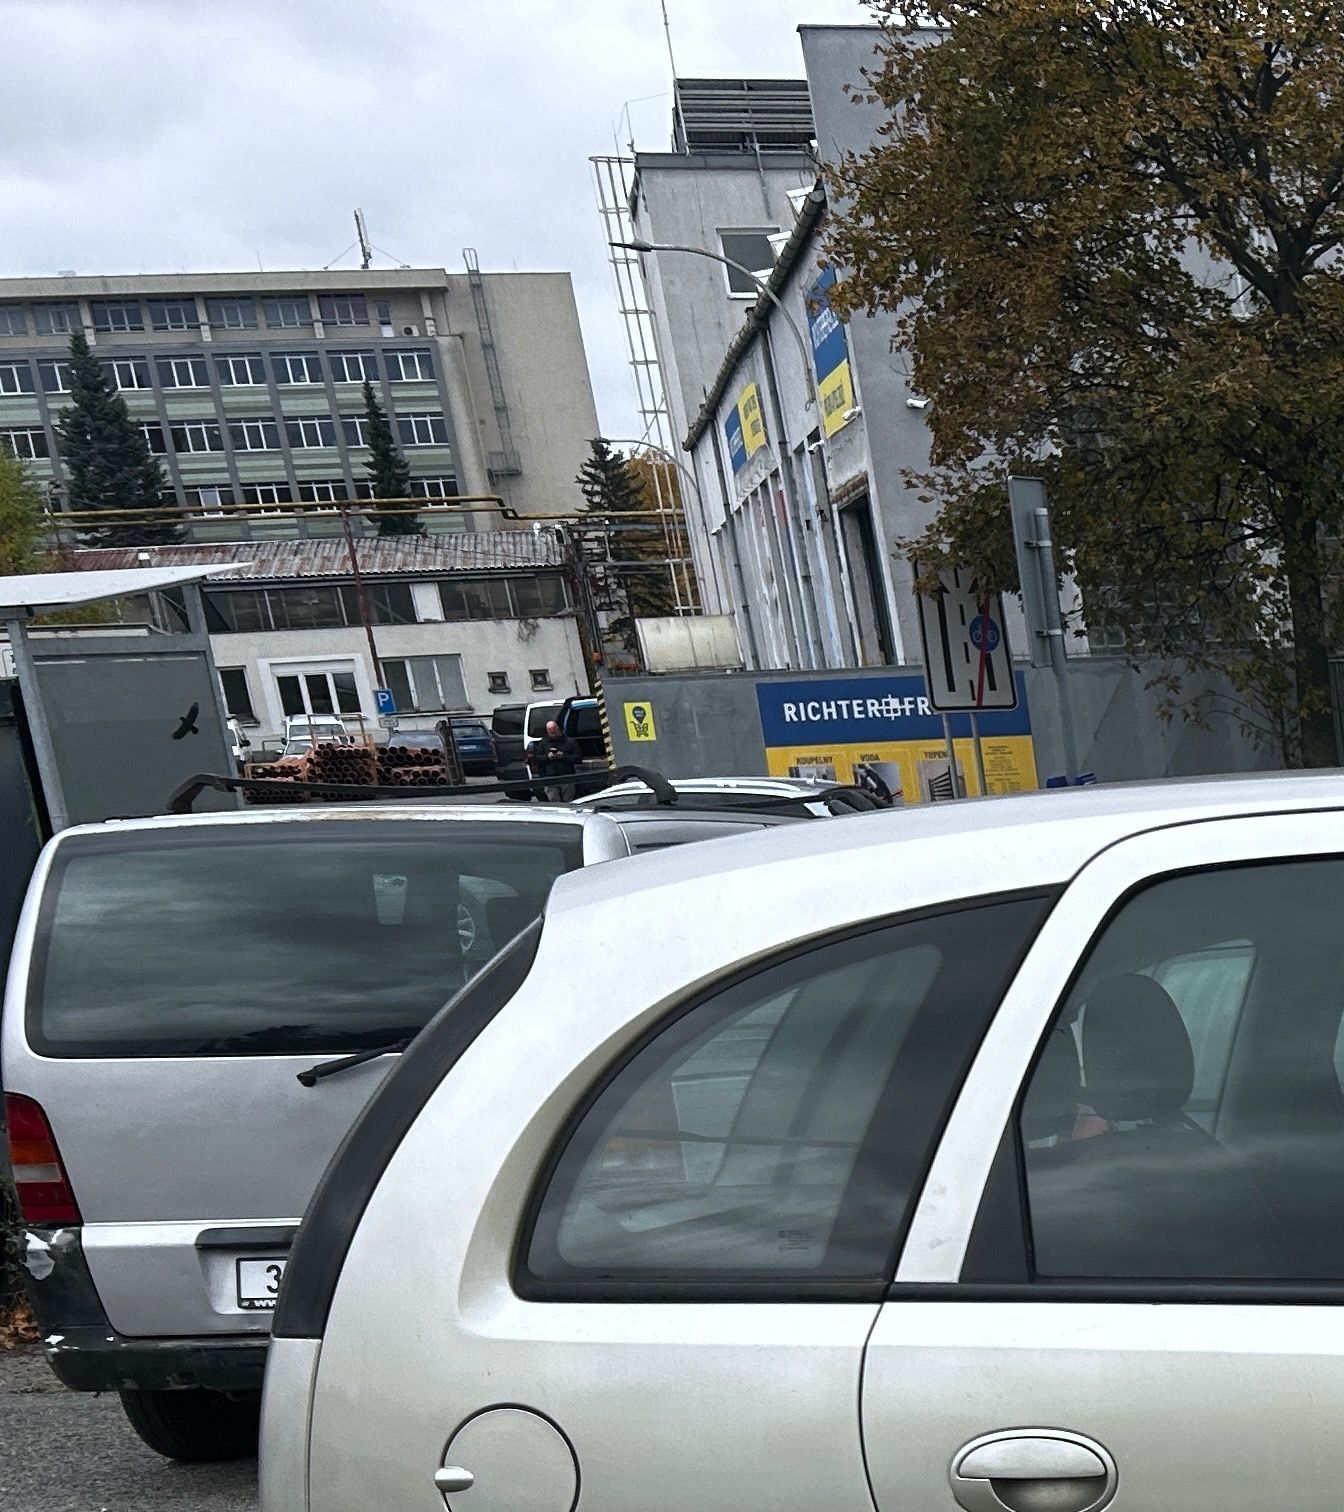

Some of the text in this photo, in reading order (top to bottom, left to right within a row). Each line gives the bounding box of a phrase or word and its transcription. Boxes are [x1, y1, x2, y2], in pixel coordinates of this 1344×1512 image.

[377, 692, 390, 707] P
[783, 699, 880, 722] RICHTER
[860, 754, 880, 762] VODA
[923, 751, 948, 759] TOPEN
